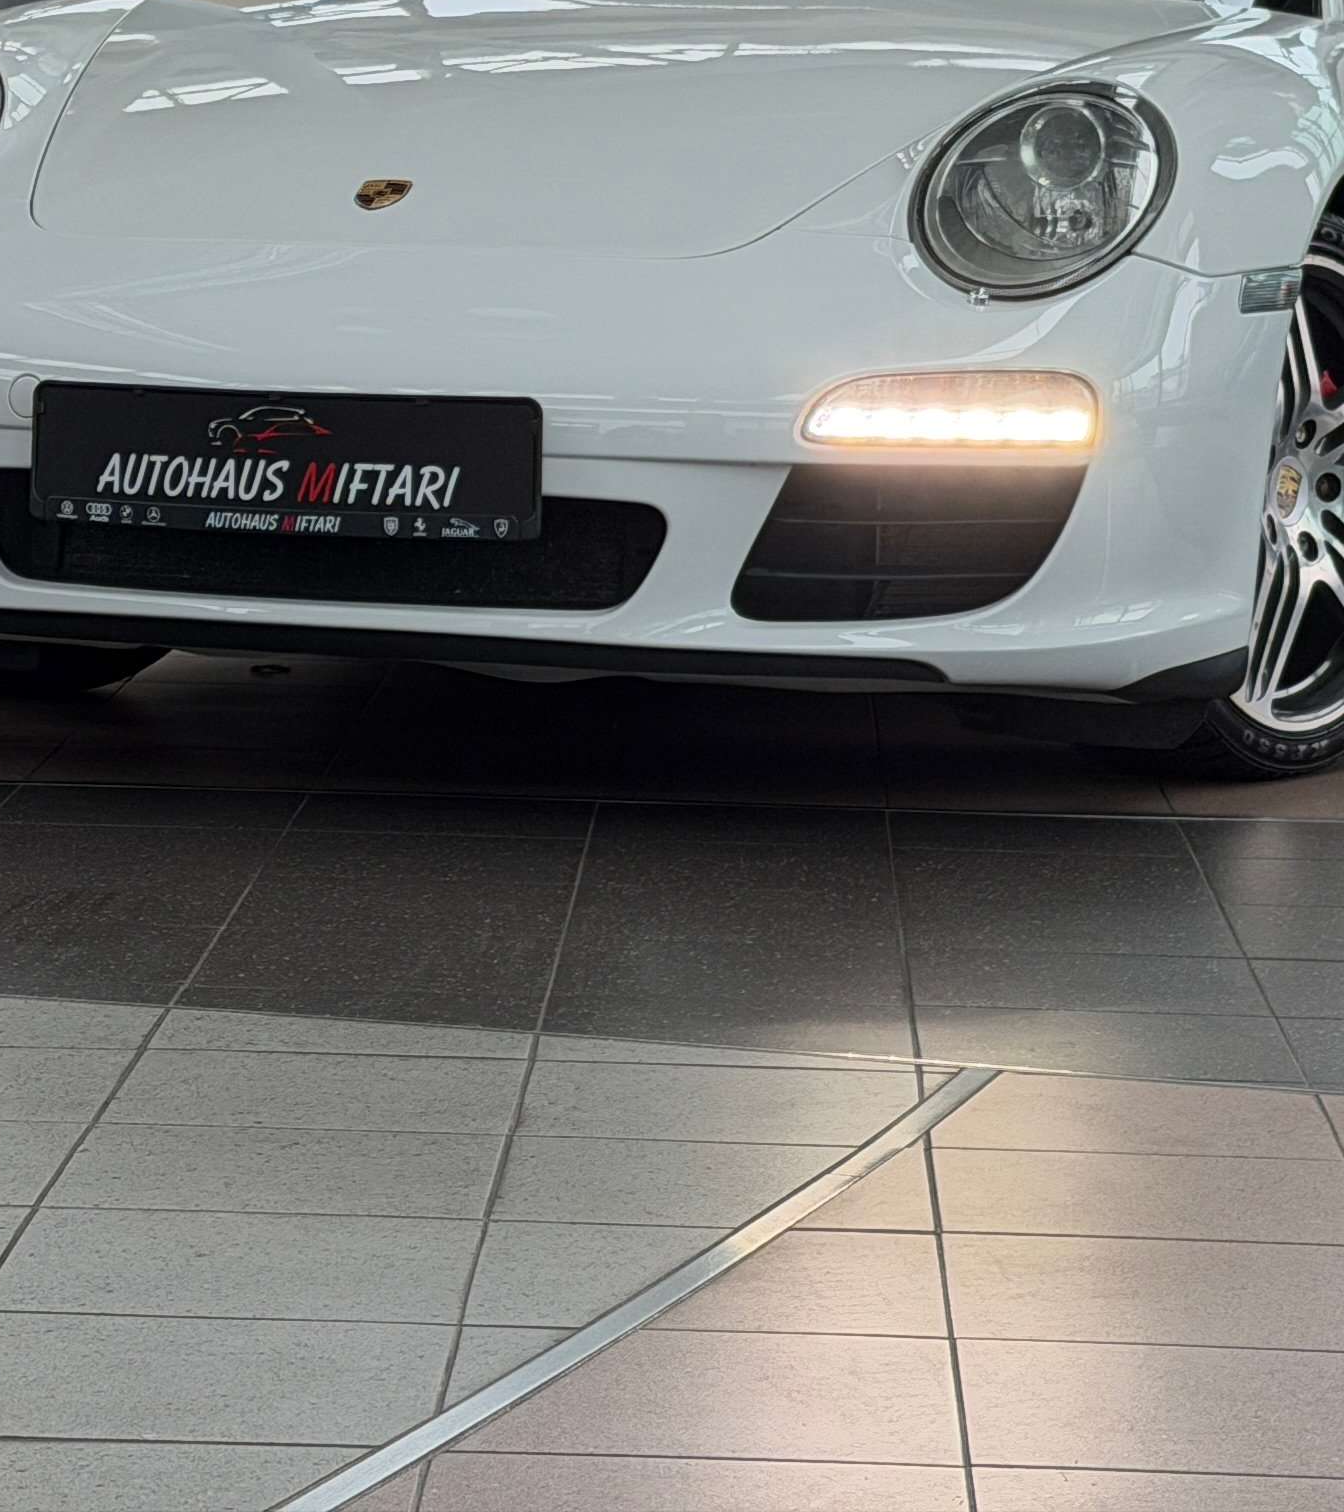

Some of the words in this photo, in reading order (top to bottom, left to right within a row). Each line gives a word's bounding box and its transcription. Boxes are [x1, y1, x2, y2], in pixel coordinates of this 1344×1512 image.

[96, 453, 291, 503] AUTOHAUS
[297, 460, 461, 510] MIFTARI
[205, 511, 279, 531] AUTOHAUS
[281, 514, 341, 533] MIFTARI
[441, 528, 474, 537] JAGUAR
